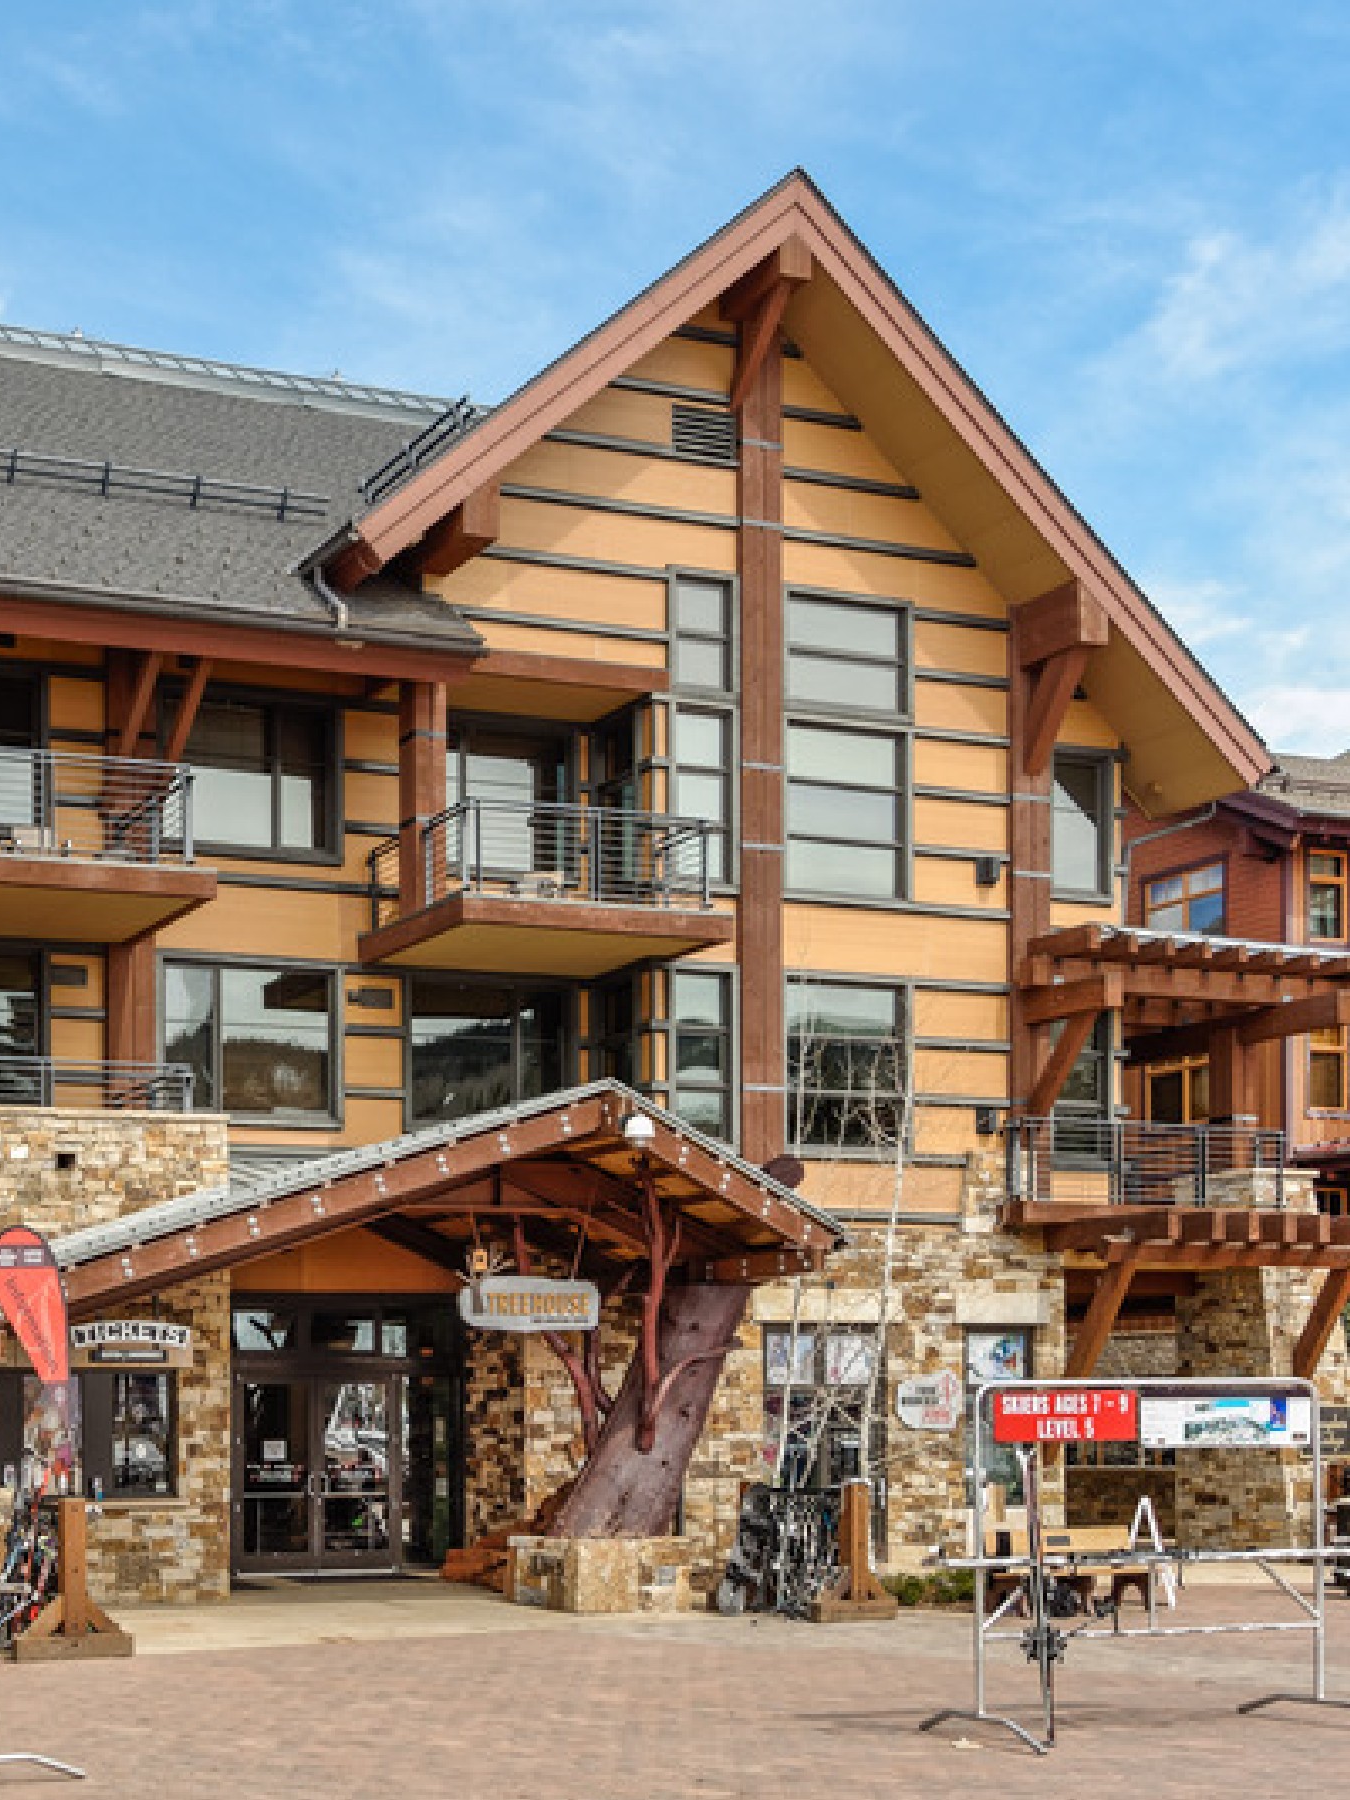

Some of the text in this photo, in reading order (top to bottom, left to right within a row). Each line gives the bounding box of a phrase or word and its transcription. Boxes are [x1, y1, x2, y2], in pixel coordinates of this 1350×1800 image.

[487, 1291, 590, 1316] TREEHOUSE
[73, 1323, 188, 1345] TICKETS
[1002, 1394, 1050, 1415] SKIERS
[1053, 1394, 1088, 1415] AGES
[1092, 1393, 1102, 1414] 7
[1118, 1394, 1129, 1414] 9
[1036, 1417, 1081, 1439] LEVEL
